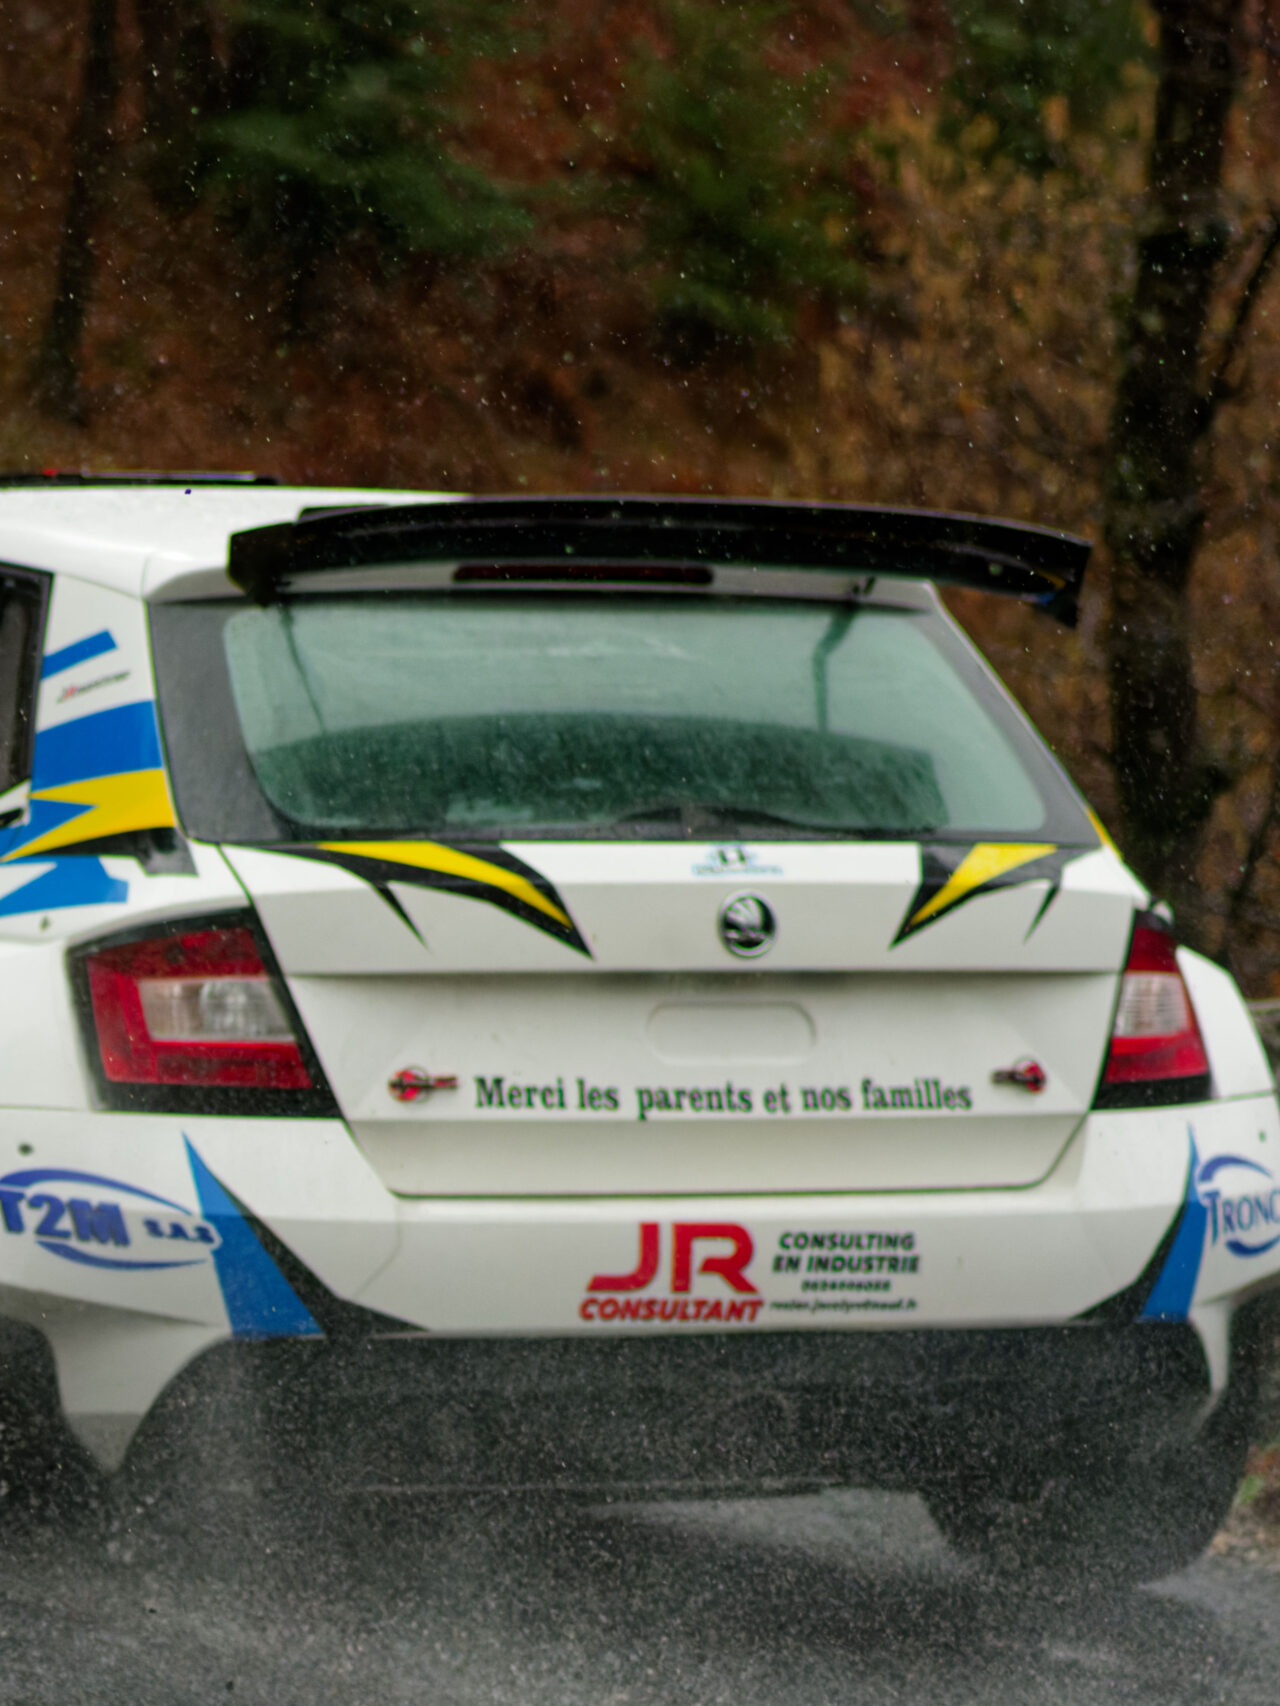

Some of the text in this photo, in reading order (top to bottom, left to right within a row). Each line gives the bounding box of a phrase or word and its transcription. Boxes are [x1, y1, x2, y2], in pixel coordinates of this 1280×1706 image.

[474, 1076, 973, 1121] Merci les parents et nos familles
[778, 1231, 915, 1251] CONSULTING
[586, 1220, 759, 1294] JR
[772, 1255, 920, 1274] EN INDUSTRIE
[578, 1297, 764, 1323] CONSULTANT
